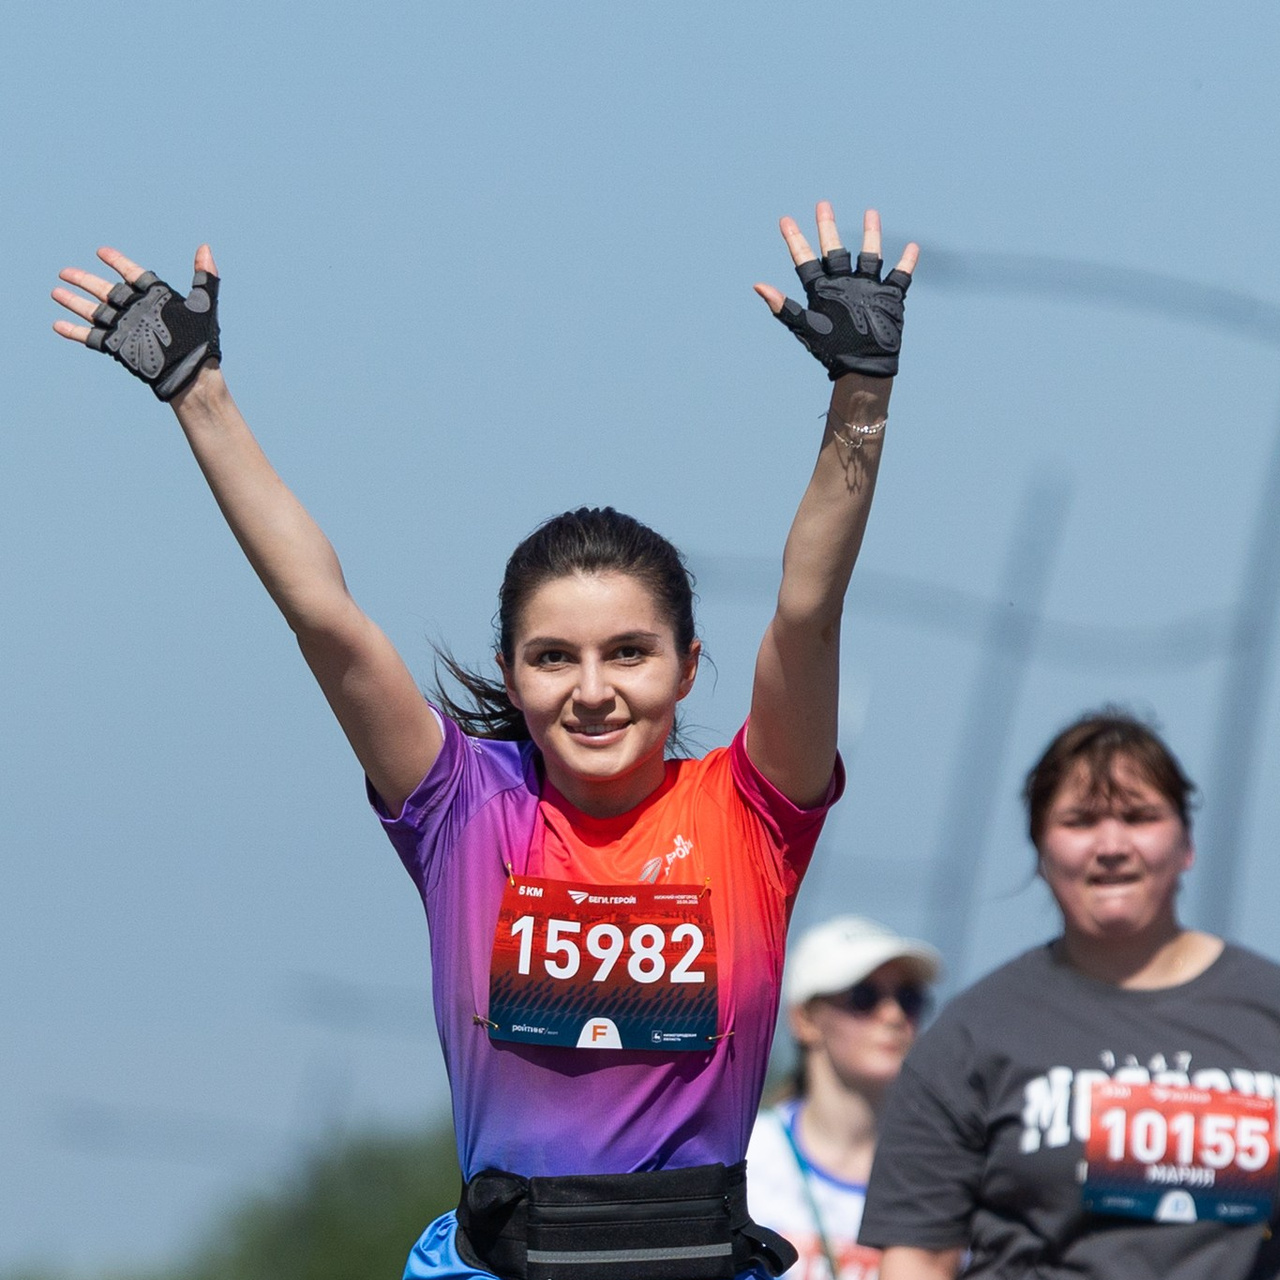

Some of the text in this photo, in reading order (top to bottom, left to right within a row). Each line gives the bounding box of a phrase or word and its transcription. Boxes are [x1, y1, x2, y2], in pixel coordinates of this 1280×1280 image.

[518, 885, 526, 895] 5
[510, 915, 705, 983] 15982
[591, 1025, 608, 1041] F
[1100, 1107, 1270, 1172] 10155
[1146, 1163, 1216, 1187] МАРИЯ
